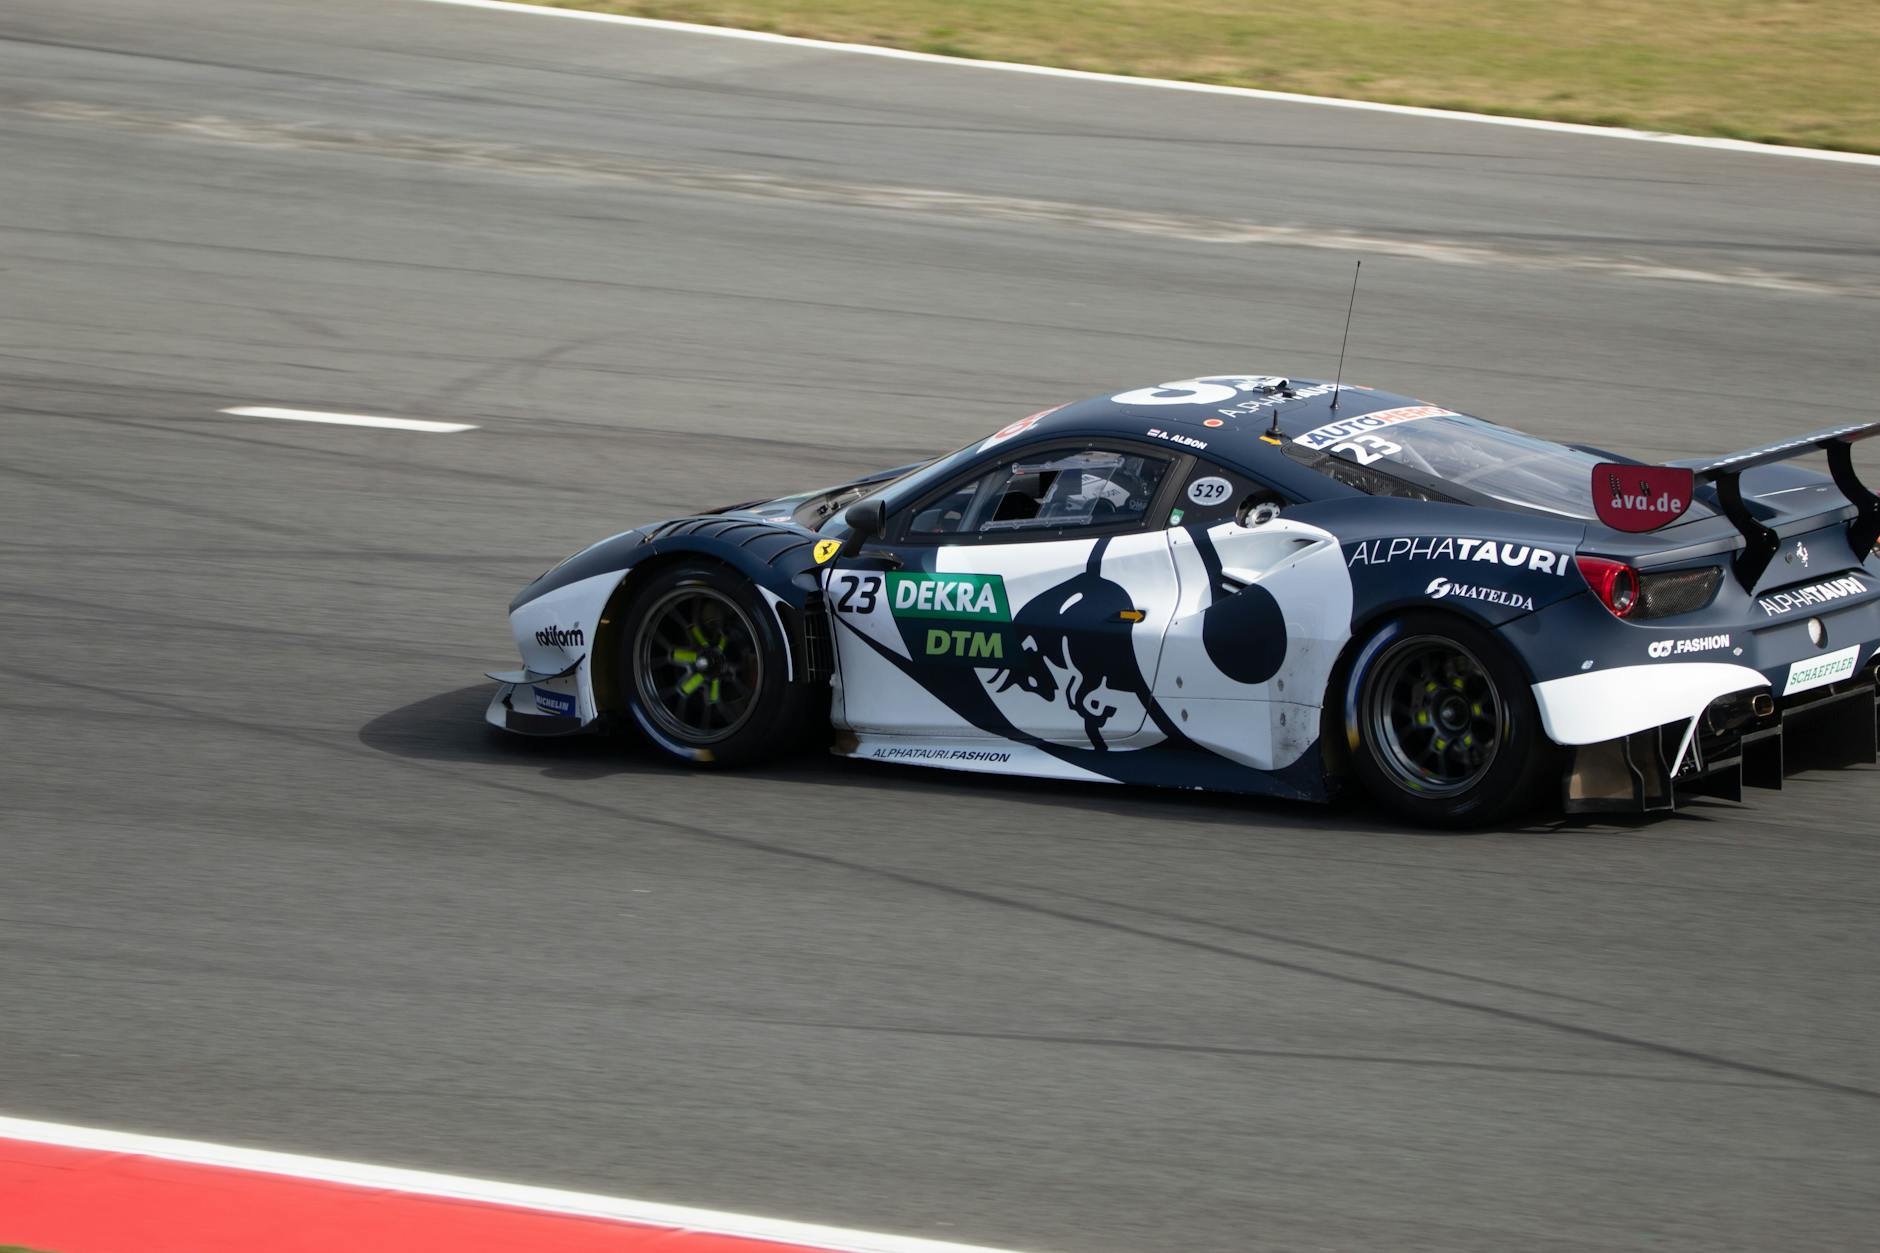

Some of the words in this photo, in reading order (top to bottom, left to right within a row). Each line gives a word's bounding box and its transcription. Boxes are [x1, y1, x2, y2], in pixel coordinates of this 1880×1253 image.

[1158, 431, 1169, 440] A.
[1170, 434, 1208, 450] ALBON
[1331, 434, 1402, 466] 23
[1193, 484, 1225, 498] 529
[1611, 492, 1681, 513] ava.de
[1349, 537, 1570, 577] ALPHATAURI
[837, 575, 881, 615] 23
[895, 579, 998, 614] DEKRA
[1451, 583, 1534, 611] MATELDA
[1759, 576, 1868, 617] ALPHATAURI
[535, 625, 584, 653] rotiform
[925, 629, 1004, 659] DTM
[1790, 657, 1854, 686] SCHAEFFLER
[535, 694, 569, 711] MICHELIN
